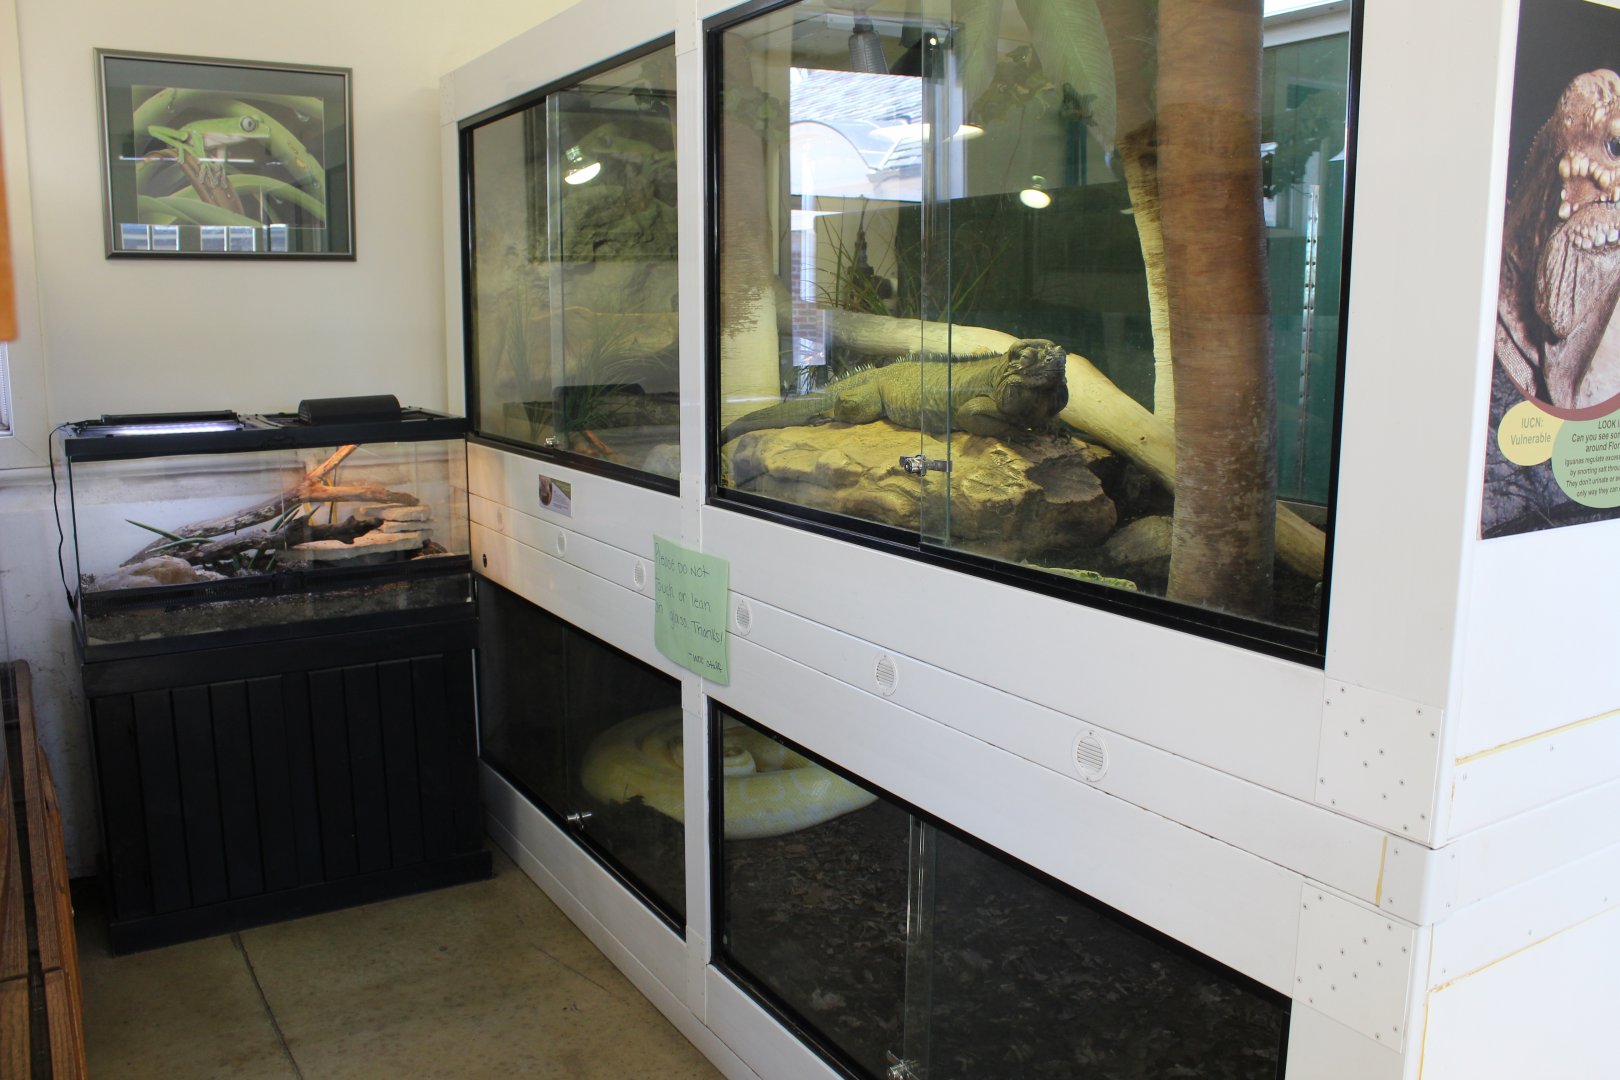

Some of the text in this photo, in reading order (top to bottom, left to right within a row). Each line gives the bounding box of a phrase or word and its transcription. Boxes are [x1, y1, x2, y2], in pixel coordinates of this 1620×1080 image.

[1598, 419, 1616, 430] LOOK
[1510, 432, 1552, 446] Vulnerable
[1571, 433, 1584, 443] Can
[1585, 433, 1597, 444] you
[1598, 433, 1609, 441] see
[1585, 442, 1607, 453] around
[1585, 455, 1604, 465] regulate
[1569, 470, 1576, 478] by
[1566, 480, 1578, 488] They
[1579, 478, 1592, 486] don't
[1576, 489, 1587, 498] only
[1588, 488, 1598, 496] way
[1598, 486, 1608, 495] they
[677, 562, 688, 574] DO
[678, 591, 687, 603] or
[691, 591, 711, 613] lean
